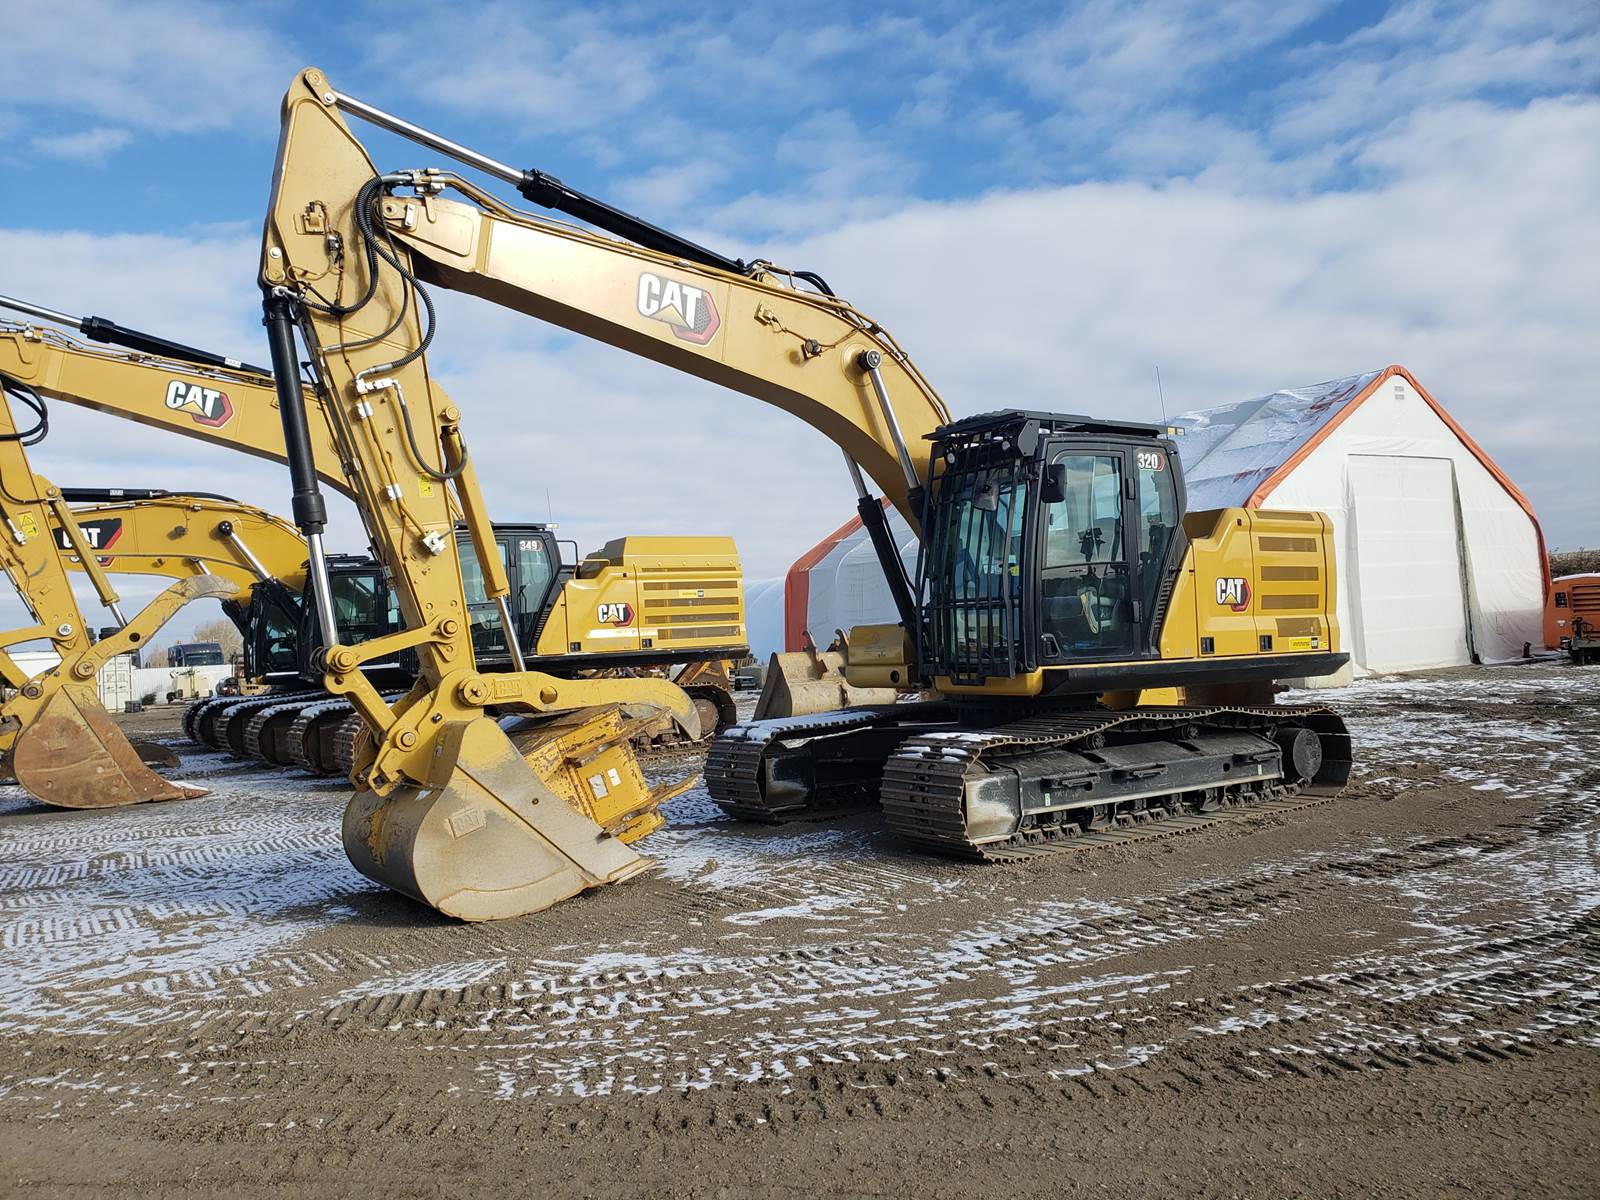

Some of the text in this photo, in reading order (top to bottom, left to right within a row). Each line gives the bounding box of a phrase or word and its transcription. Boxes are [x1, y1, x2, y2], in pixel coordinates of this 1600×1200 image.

[638, 272, 702, 330] CAT
[166, 380, 220, 418] CAT
[1138, 453, 1158, 469] 320
[520, 540, 537, 550] 349
[1216, 578, 1244, 604] CAT
[597, 604, 626, 623] CAT
